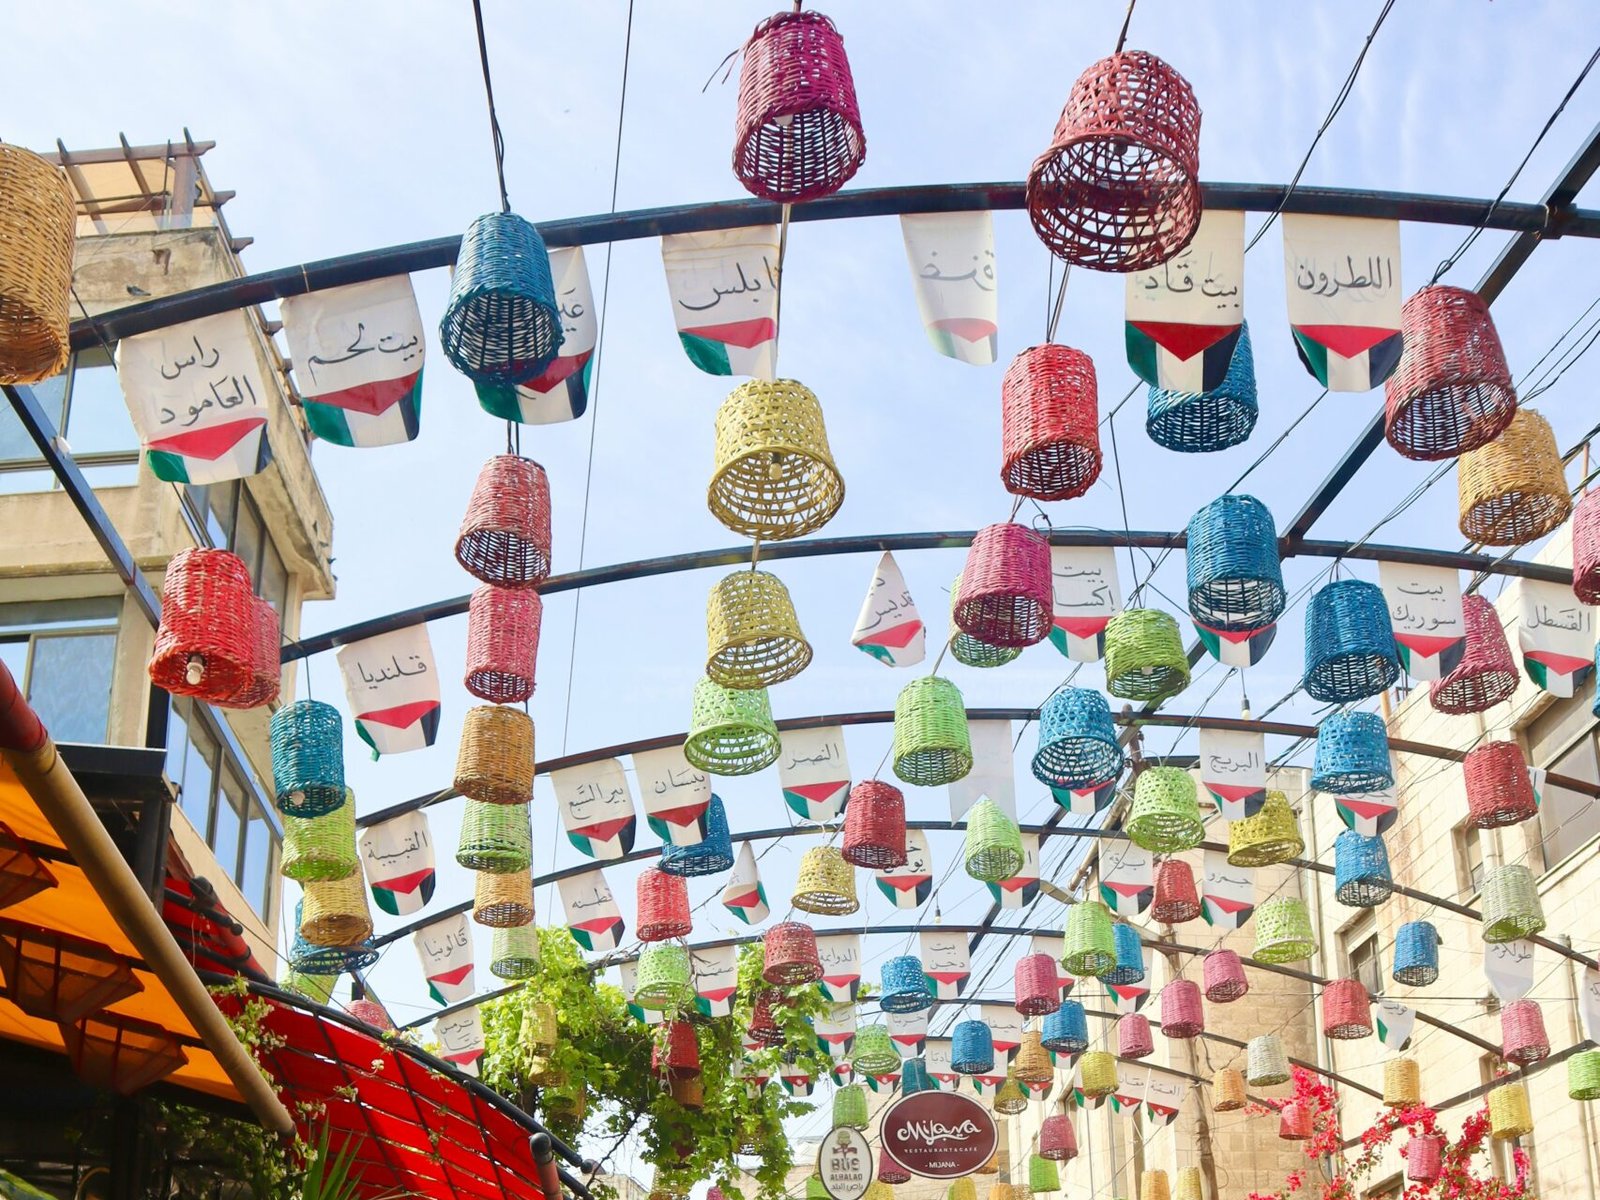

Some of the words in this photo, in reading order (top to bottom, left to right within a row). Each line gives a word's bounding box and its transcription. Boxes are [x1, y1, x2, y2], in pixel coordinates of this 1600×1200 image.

[679, 256, 783, 310] ابلس
[1297, 255, 1393, 299] اللطرون
[1201, 278, 1240, 309] بيت
[161, 336, 219, 379] راس
[308, 323, 375, 386] لحم
[377, 335, 424, 361] بيت
[1052, 566, 1105, 583] بيت
[1397, 582, 1446, 602] بيت
[1392, 604, 1457, 631] سوريك
[357, 655, 427, 689] قلنديا
[1210, 752, 1259, 773] البريج
